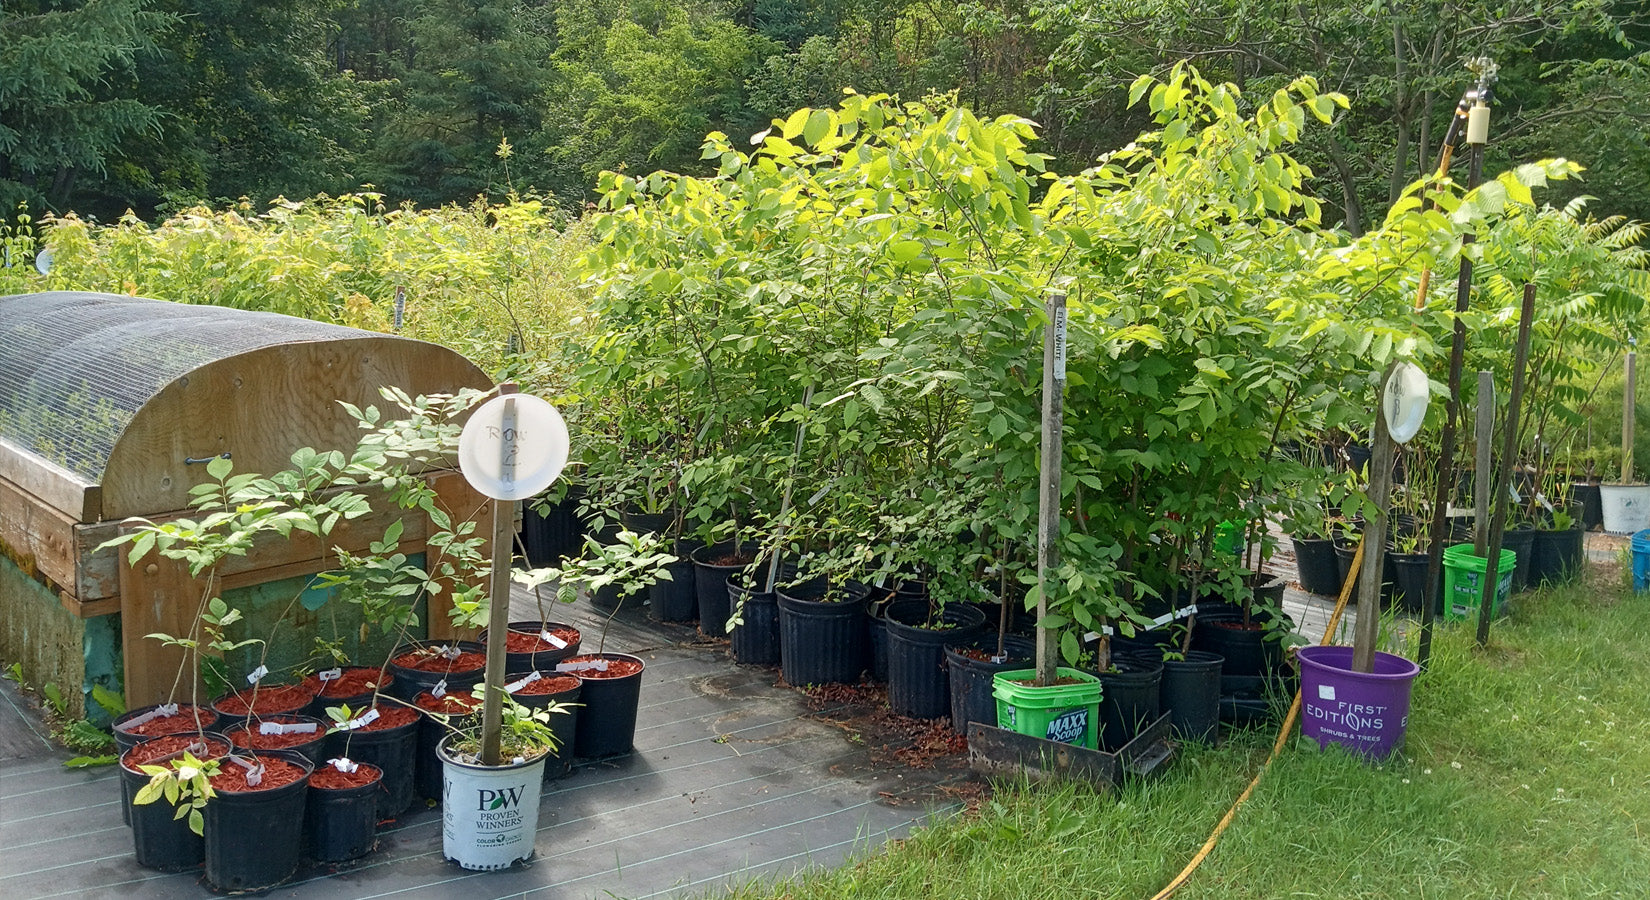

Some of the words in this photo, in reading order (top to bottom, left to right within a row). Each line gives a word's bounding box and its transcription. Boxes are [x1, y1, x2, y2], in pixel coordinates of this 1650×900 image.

[1338, 702, 1384, 716] FIRST
[1046, 711, 1088, 735] MAXX
[1306, 704, 1384, 731] EDITIONS
[1319, 726, 1349, 739] SHRUBS
[1357, 734, 1381, 742] TREES
[477, 784, 526, 811] PW
[480, 809, 520, 821] PROVEN
[476, 818, 523, 830] WINNERS
